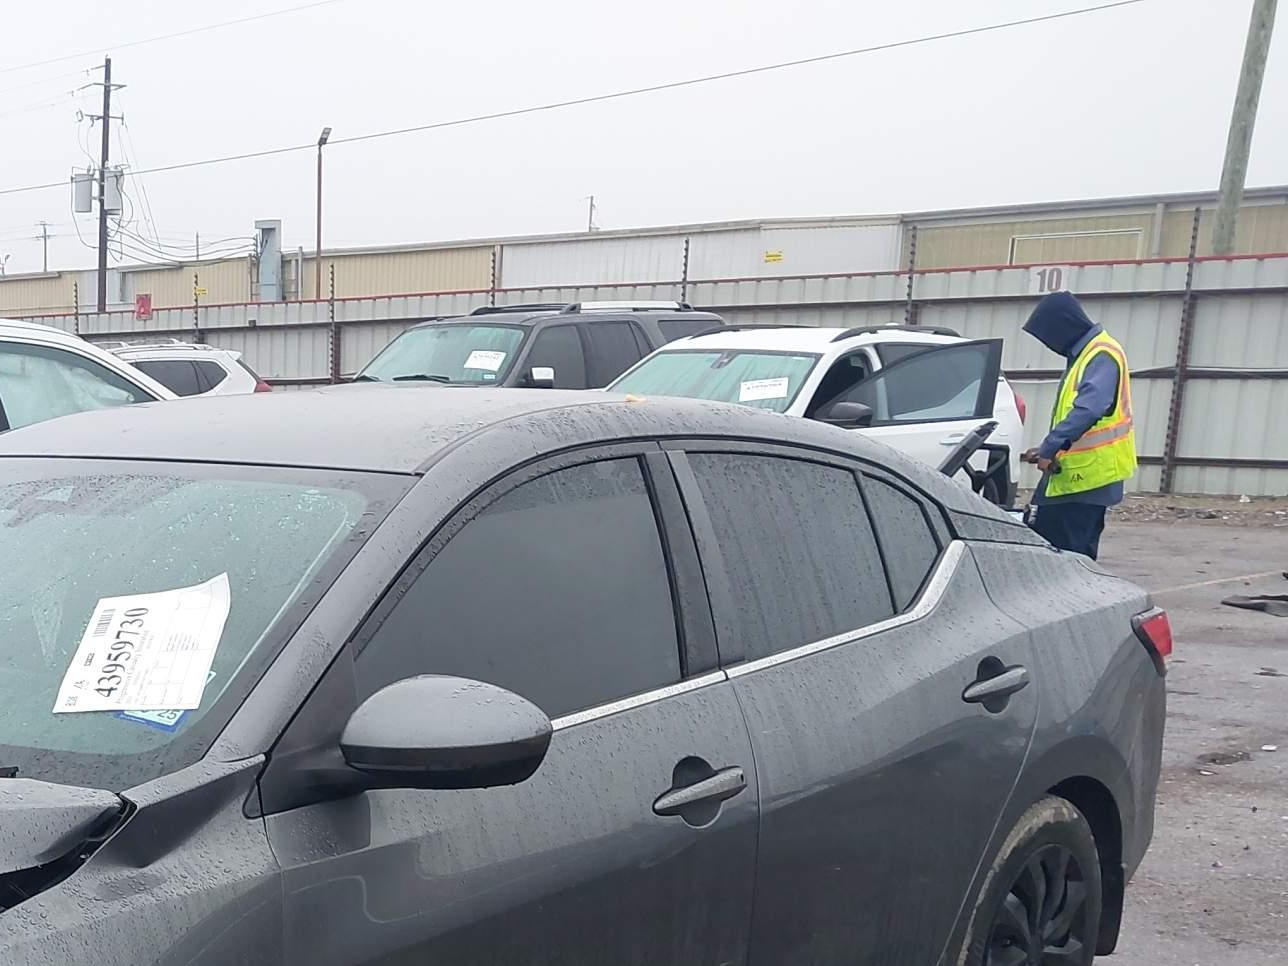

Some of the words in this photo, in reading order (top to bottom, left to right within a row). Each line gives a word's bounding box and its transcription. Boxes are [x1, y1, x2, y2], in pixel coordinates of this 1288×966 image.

[1036, 268, 1062, 293] 10
[93, 607, 149, 698] 43959730
[157, 710, 178, 720] 25
